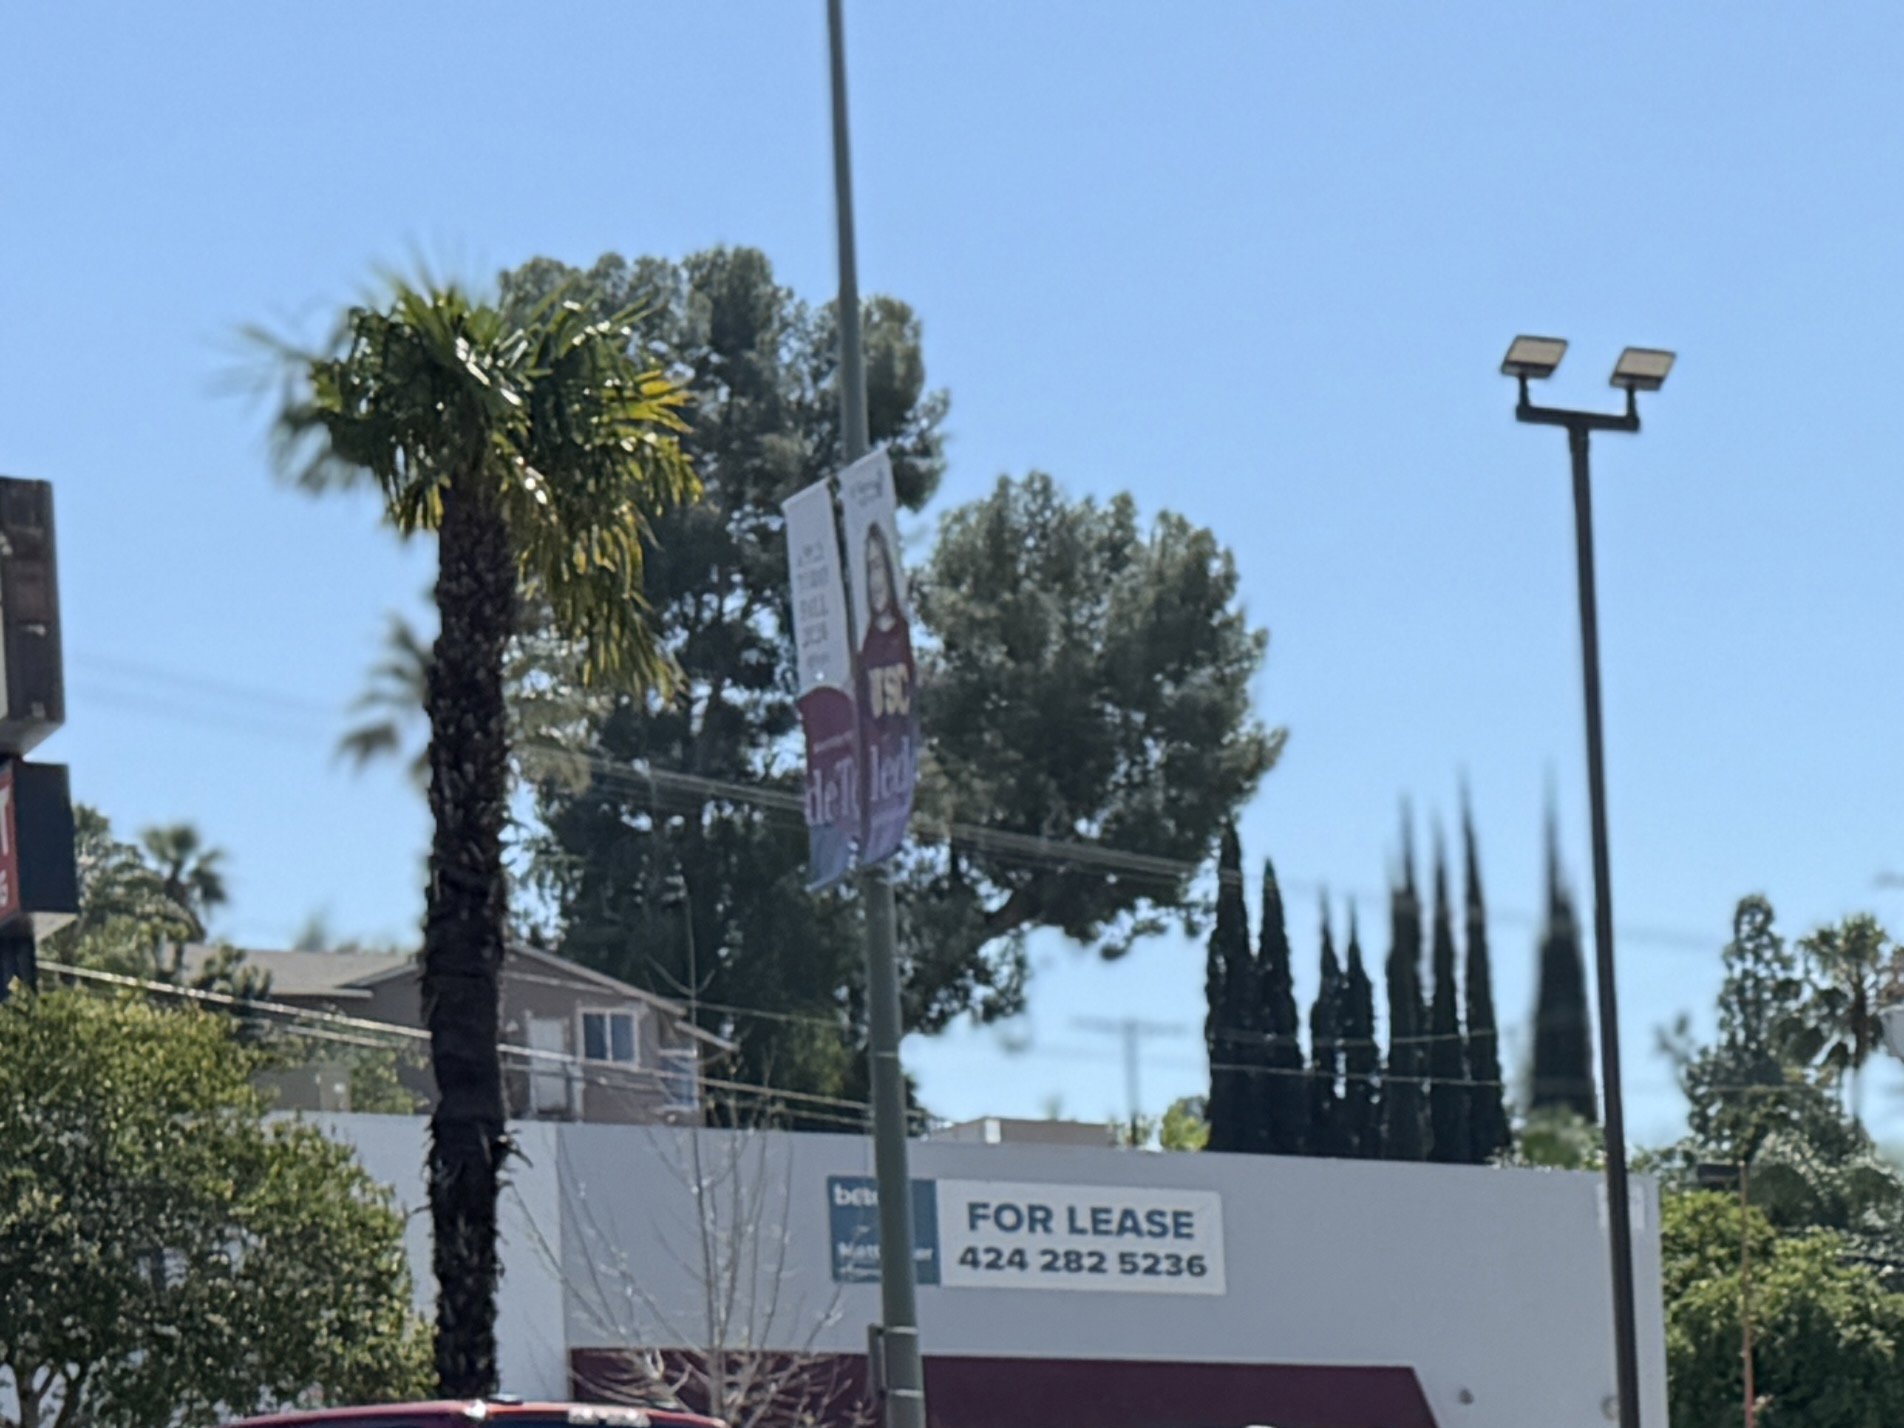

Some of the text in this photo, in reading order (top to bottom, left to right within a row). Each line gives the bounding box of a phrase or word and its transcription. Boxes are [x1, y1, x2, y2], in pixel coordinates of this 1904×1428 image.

[967, 1202, 1195, 1240] FOR LEASE
[958, 1245, 1028, 1272] 424
[1039, 1249, 1107, 1275] 282
[1118, 1252, 1208, 1278] 5236
